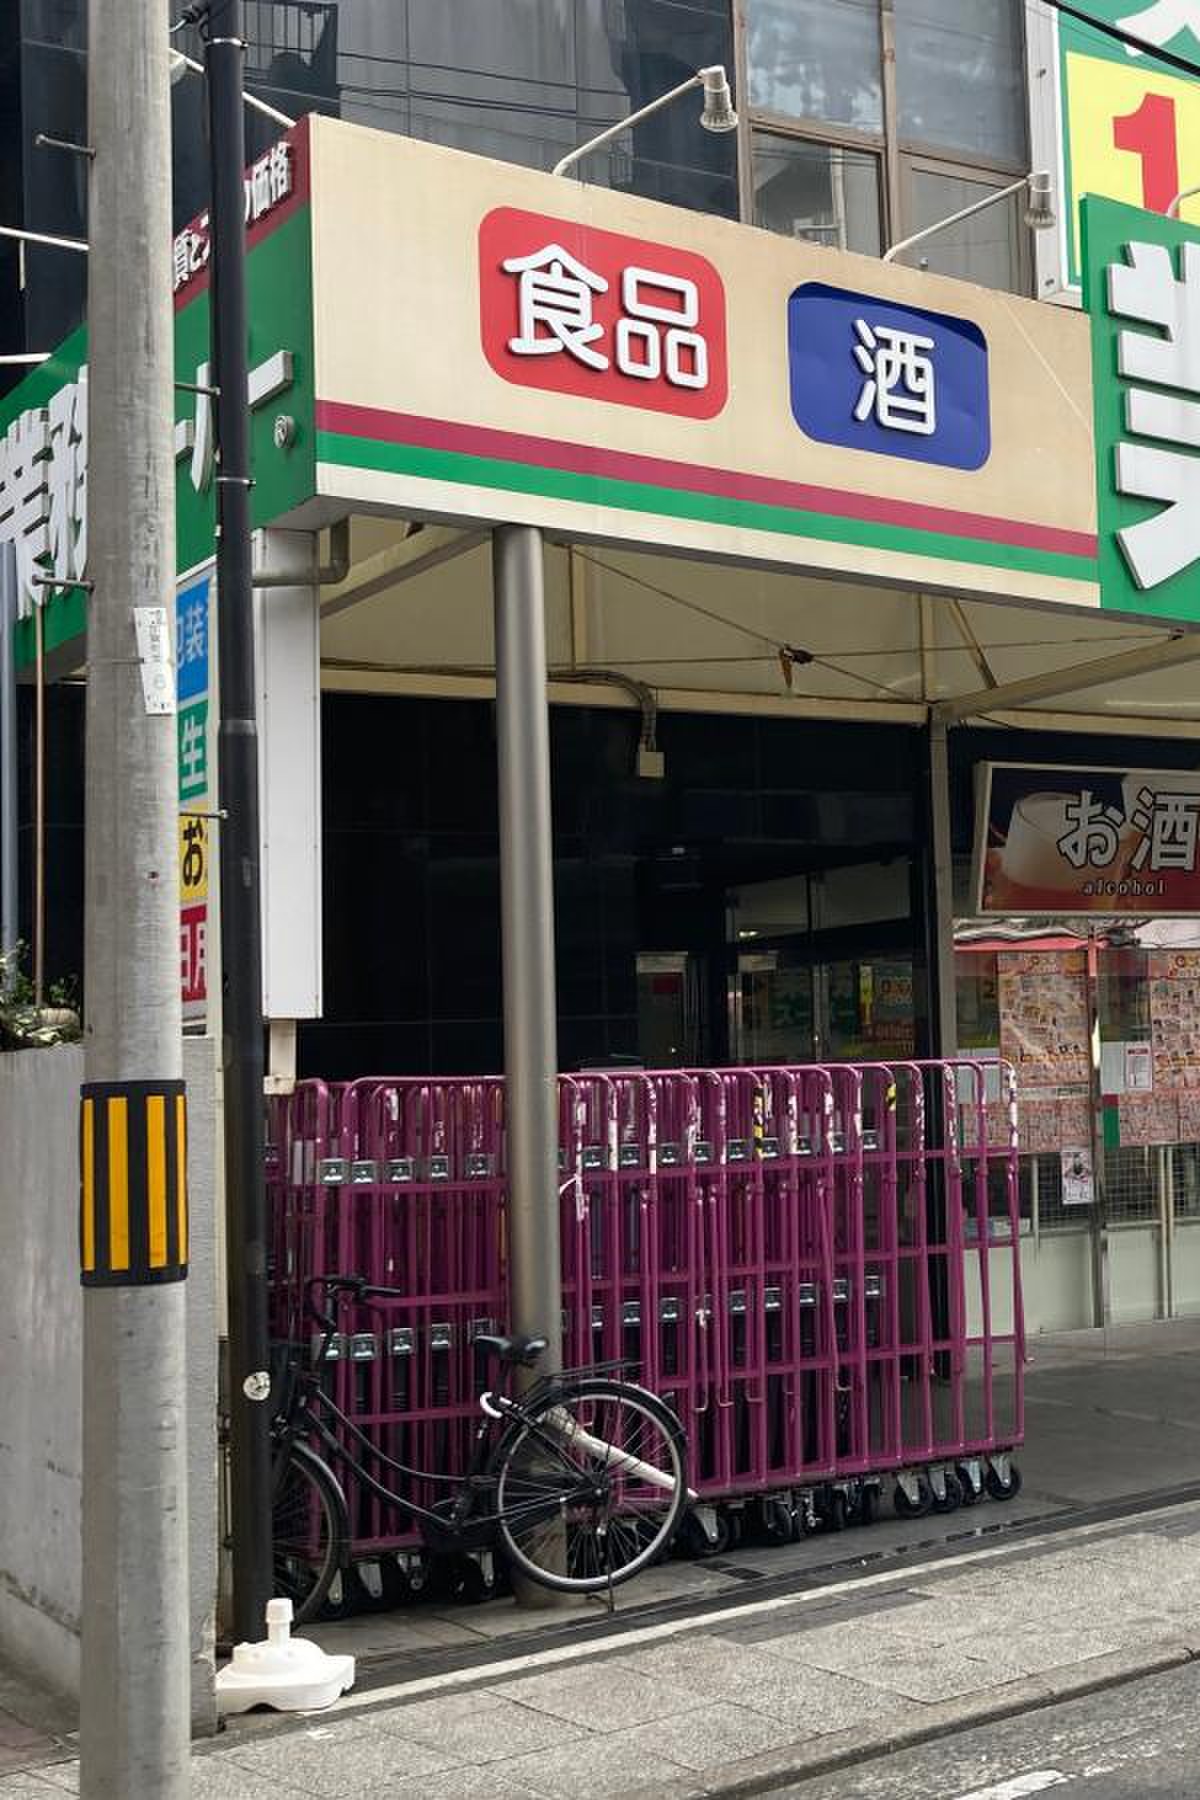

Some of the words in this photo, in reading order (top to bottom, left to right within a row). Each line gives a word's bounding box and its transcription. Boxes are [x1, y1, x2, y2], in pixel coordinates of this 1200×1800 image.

[501, 242, 709, 389] 食品
[853, 318, 937, 436] 酒
[1083, 880, 1166, 896] alcohol
